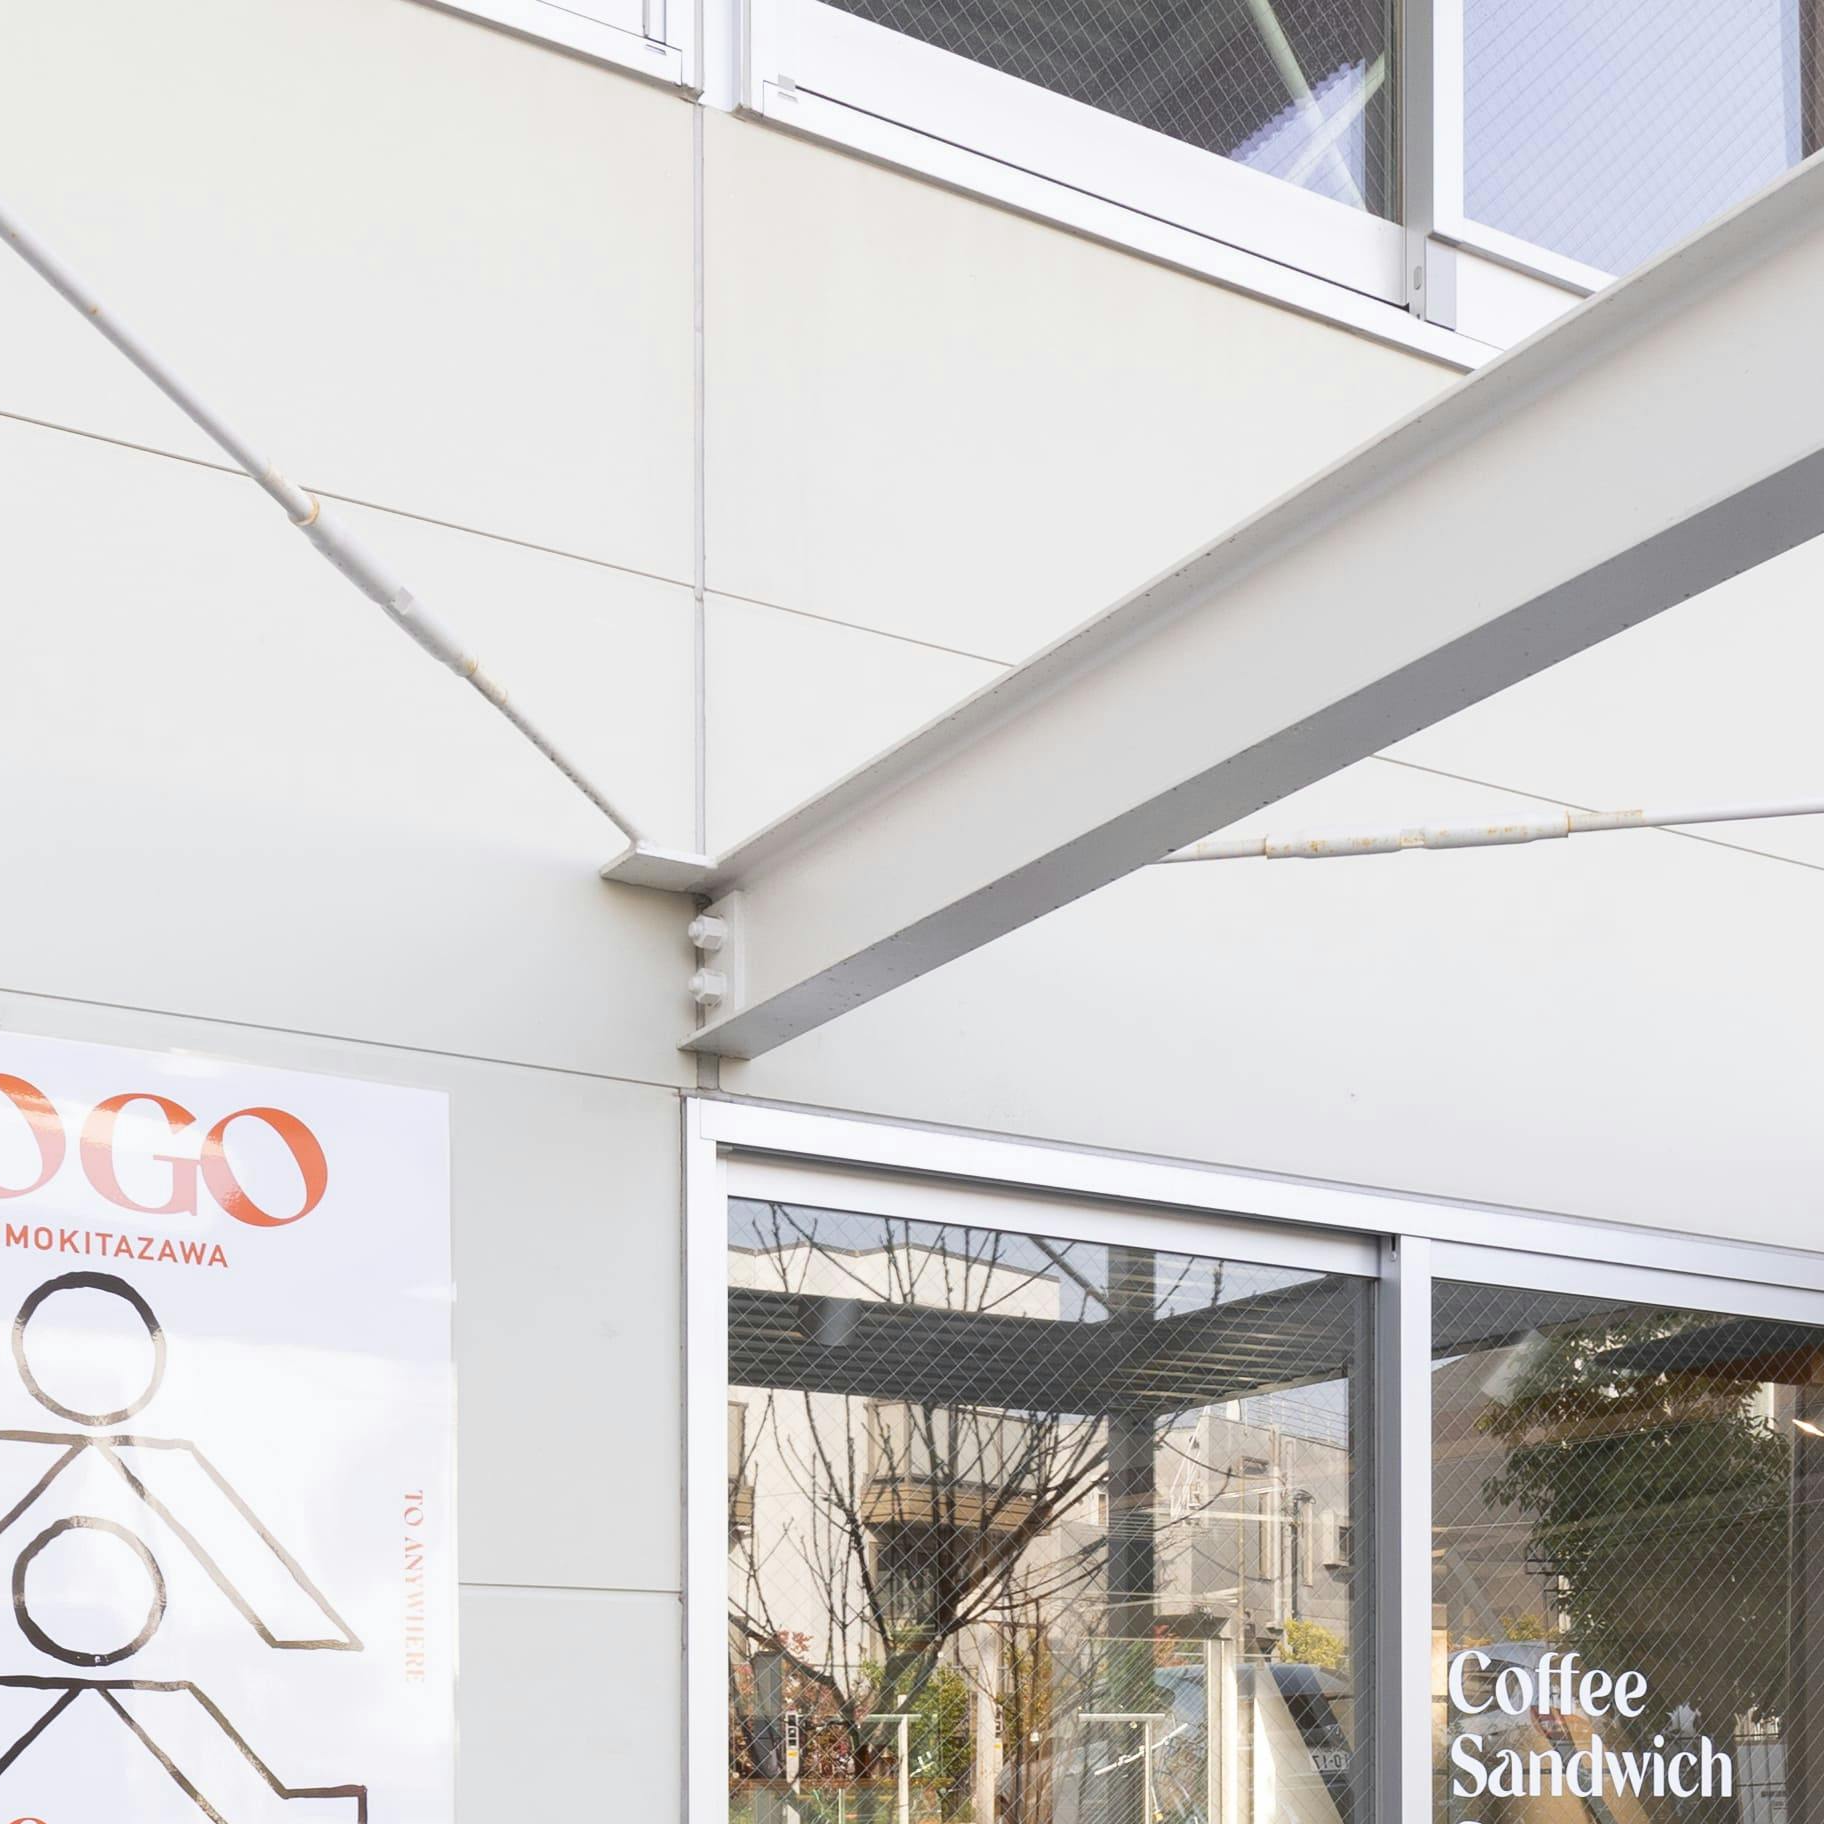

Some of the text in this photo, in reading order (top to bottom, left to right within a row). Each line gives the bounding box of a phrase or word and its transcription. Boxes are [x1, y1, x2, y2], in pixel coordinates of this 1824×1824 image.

[402, 1489, 426, 1683] TO ANYWHERE
[1448, 1650, 1648, 1718] Coffee
[1450, 1733, 1733, 1798] Sandwich
